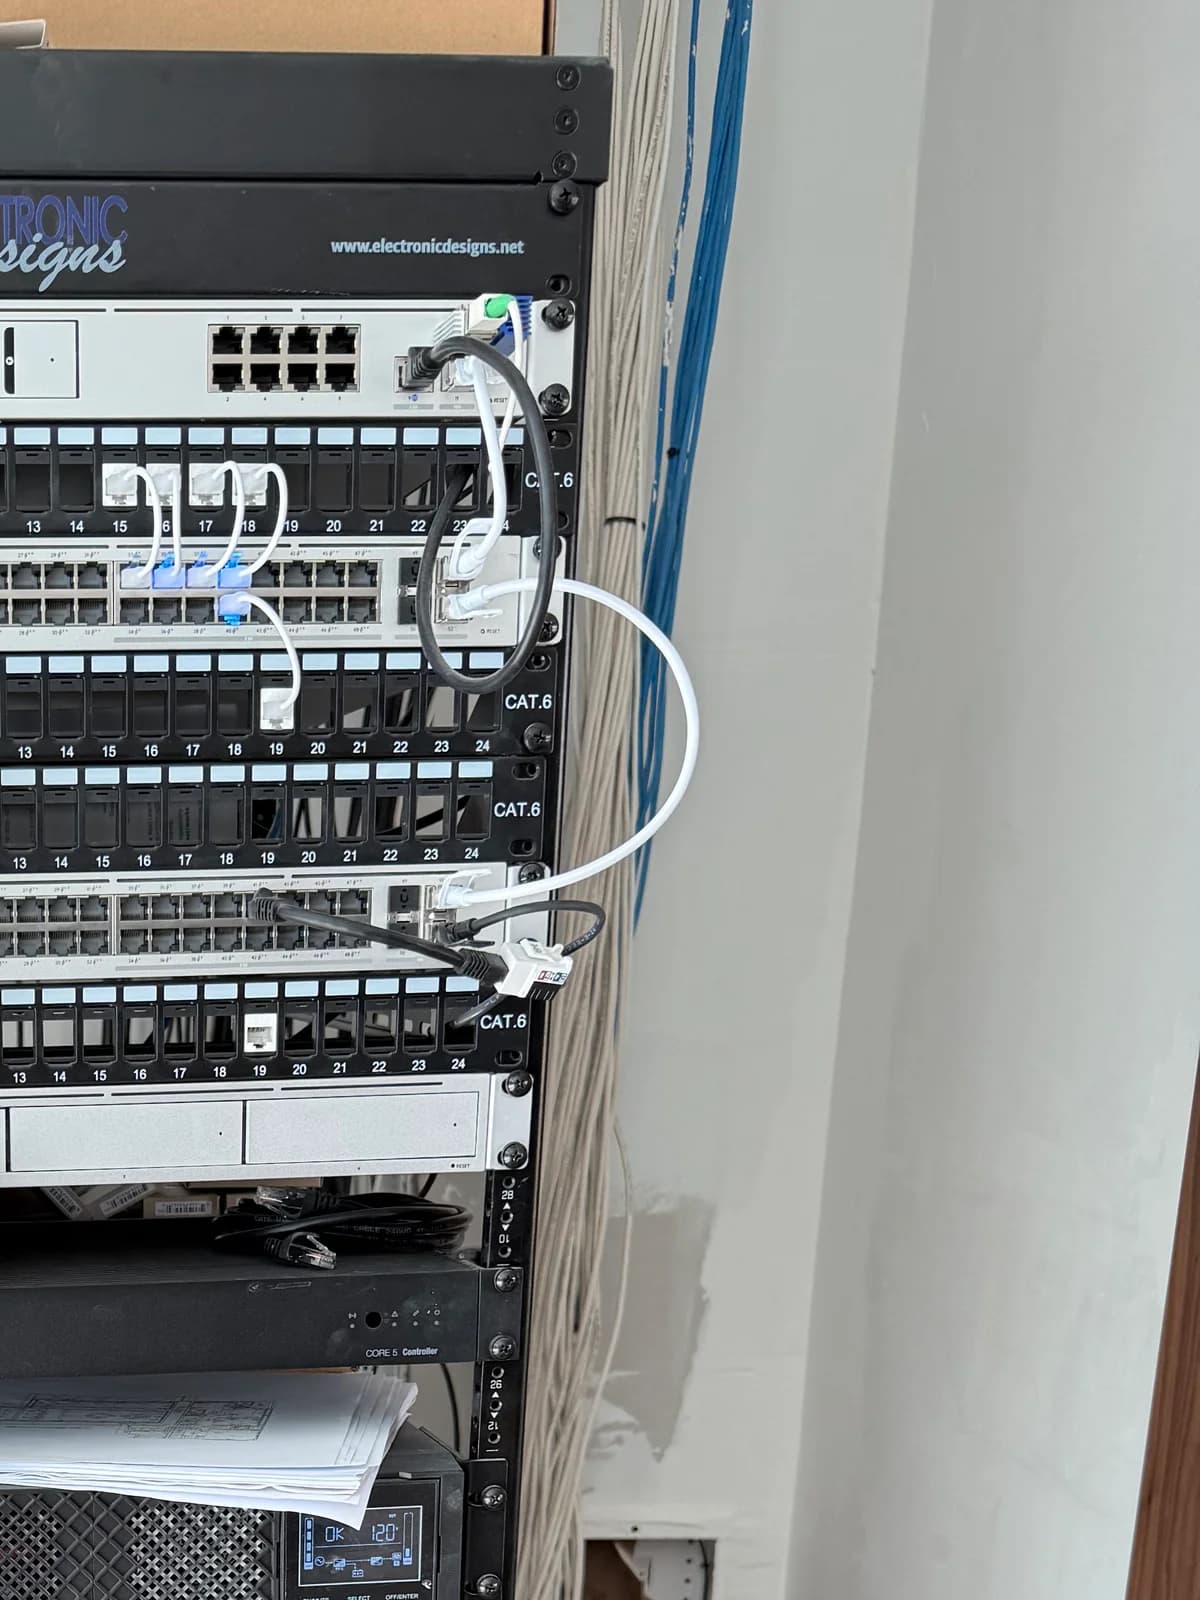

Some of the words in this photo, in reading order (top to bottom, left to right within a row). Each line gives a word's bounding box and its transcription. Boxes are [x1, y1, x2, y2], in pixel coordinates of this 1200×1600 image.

[330, 238, 525, 258] www.electronicdesigns.net
[26, 520, 41, 533] 13
[69, 520, 85, 533] 14
[112, 520, 128, 533] 15
[198, 519, 214, 533] 17
[241, 519, 256, 532] 18
[284, 519, 299, 532] 19
[326, 519, 342, 532] 20
[369, 519, 384, 532] 21
[410, 519, 426, 532] 22
[452, 519, 467, 532] 23
[504, 694, 552, 709] CAT.6
[17, 746, 33, 759] 13
[60, 745, 75, 758] 14
[102, 745, 117, 758] 15
[144, 744, 159, 757] 16
[186, 743, 201, 757] 17
[227, 743, 242, 756] 18
[269, 742, 284, 756] 19
[310, 741, 326, 755] 20
[352, 741, 367, 754] 21
[392, 740, 409, 754] 22
[434, 740, 450, 753] 23
[475, 739, 490, 752] 24
[494, 801, 541, 817] CAT.6
[13, 857, 27, 870] 13
[54, 856, 69, 869] 14
[95, 855, 110, 868] 15
[137, 854, 152, 867] 16
[178, 853, 193, 866] 17
[219, 852, 234, 865] 18
[260, 851, 275, 864] 19
[301, 850, 317, 864] 20
[343, 849, 357, 862] 21
[383, 849, 398, 862] 22
[423, 848, 439, 861] 23
[464, 847, 479, 860] 24
[480, 1014, 527, 1029] CAT.6
[13, 1071, 27, 1084] 13
[53, 1071, 67, 1082] 14
[93, 1069, 107, 1082] 15
[133, 1068, 147, 1080] 16
[173, 1067, 187, 1079] 17
[213, 1066, 227, 1078] 18
[253, 1064, 267, 1077] 19
[292, 1063, 307, 1076] 20
[333, 1061, 347, 1074] 21
[371, 1060, 387, 1073] 22
[411, 1059, 426, 1072] 23
[451, 1057, 466, 1070] 24
[501, 1190, 514, 1200] 28
[365, 1348, 391, 1358] CORE
[392, 1348, 398, 1357] 5
[402, 1347, 439, 1356] Controller
[490, 1380, 503, 1389] 26
[325, 1526, 345, 1543] OK
